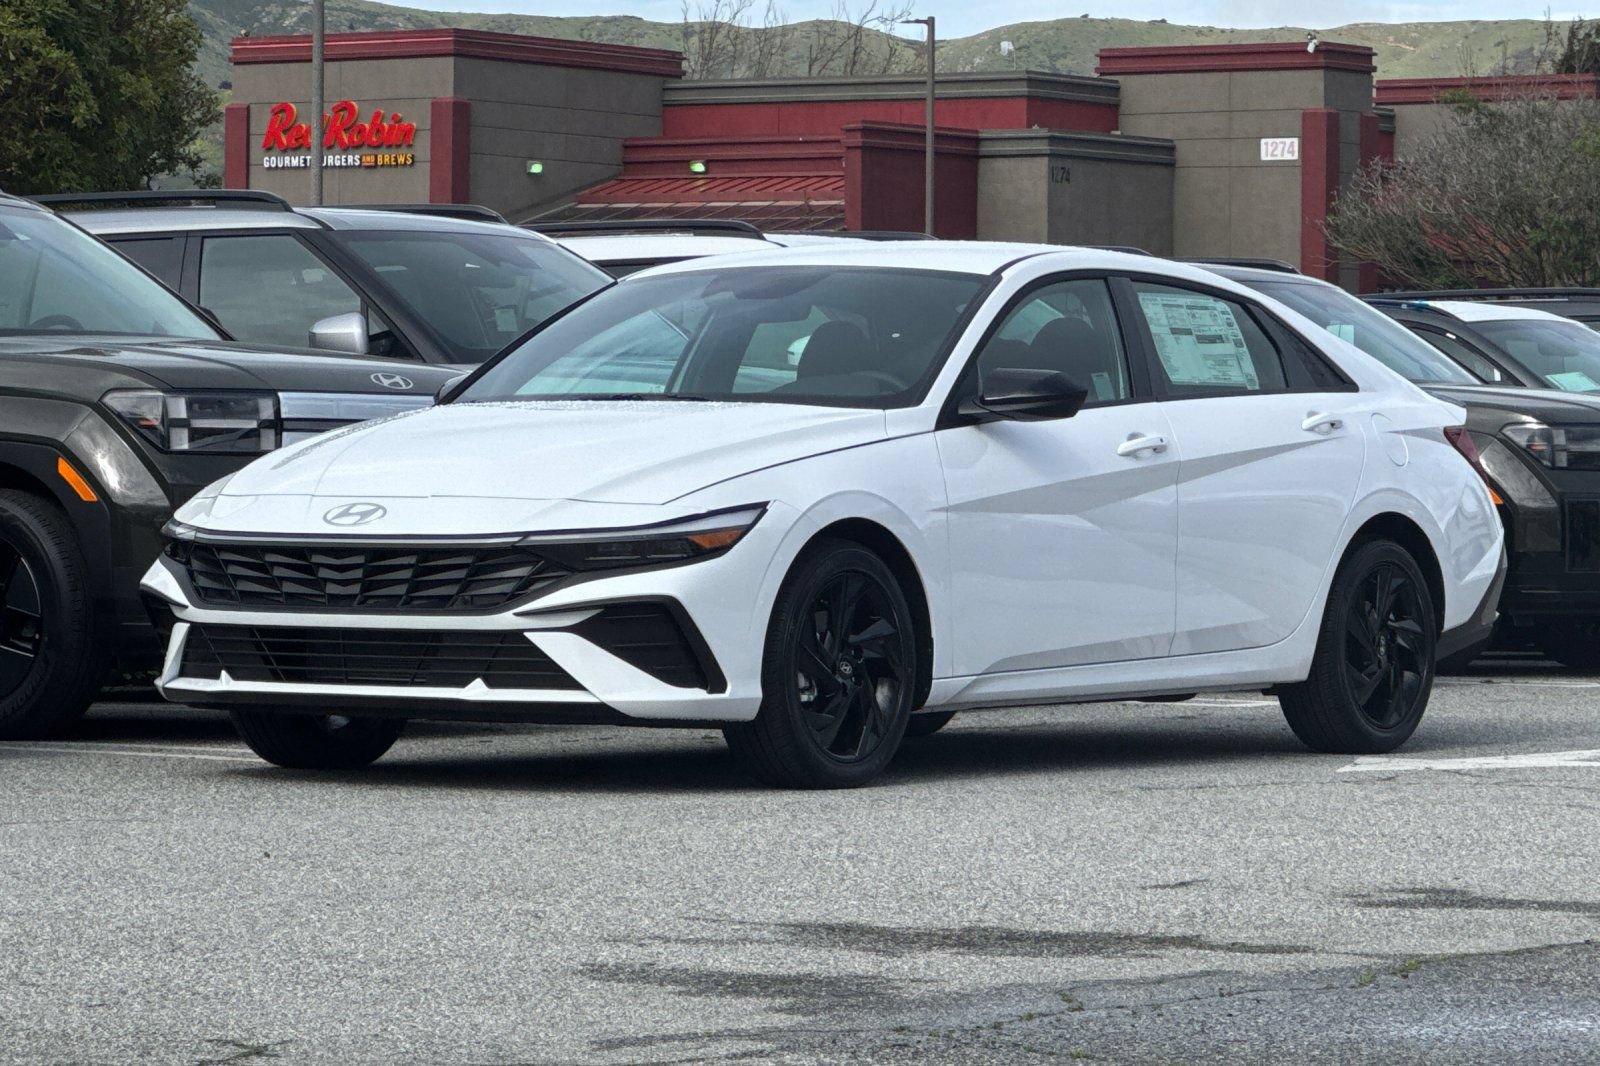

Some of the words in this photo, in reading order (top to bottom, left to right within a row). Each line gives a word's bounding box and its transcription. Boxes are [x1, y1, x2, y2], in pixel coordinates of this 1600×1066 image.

[322, 100, 416, 149] Robin
[1263, 140, 1296, 158] 1274
[263, 155, 312, 168] GOURMET
[377, 153, 413, 166] BREWS
[1051, 165, 1071, 185] 1274
